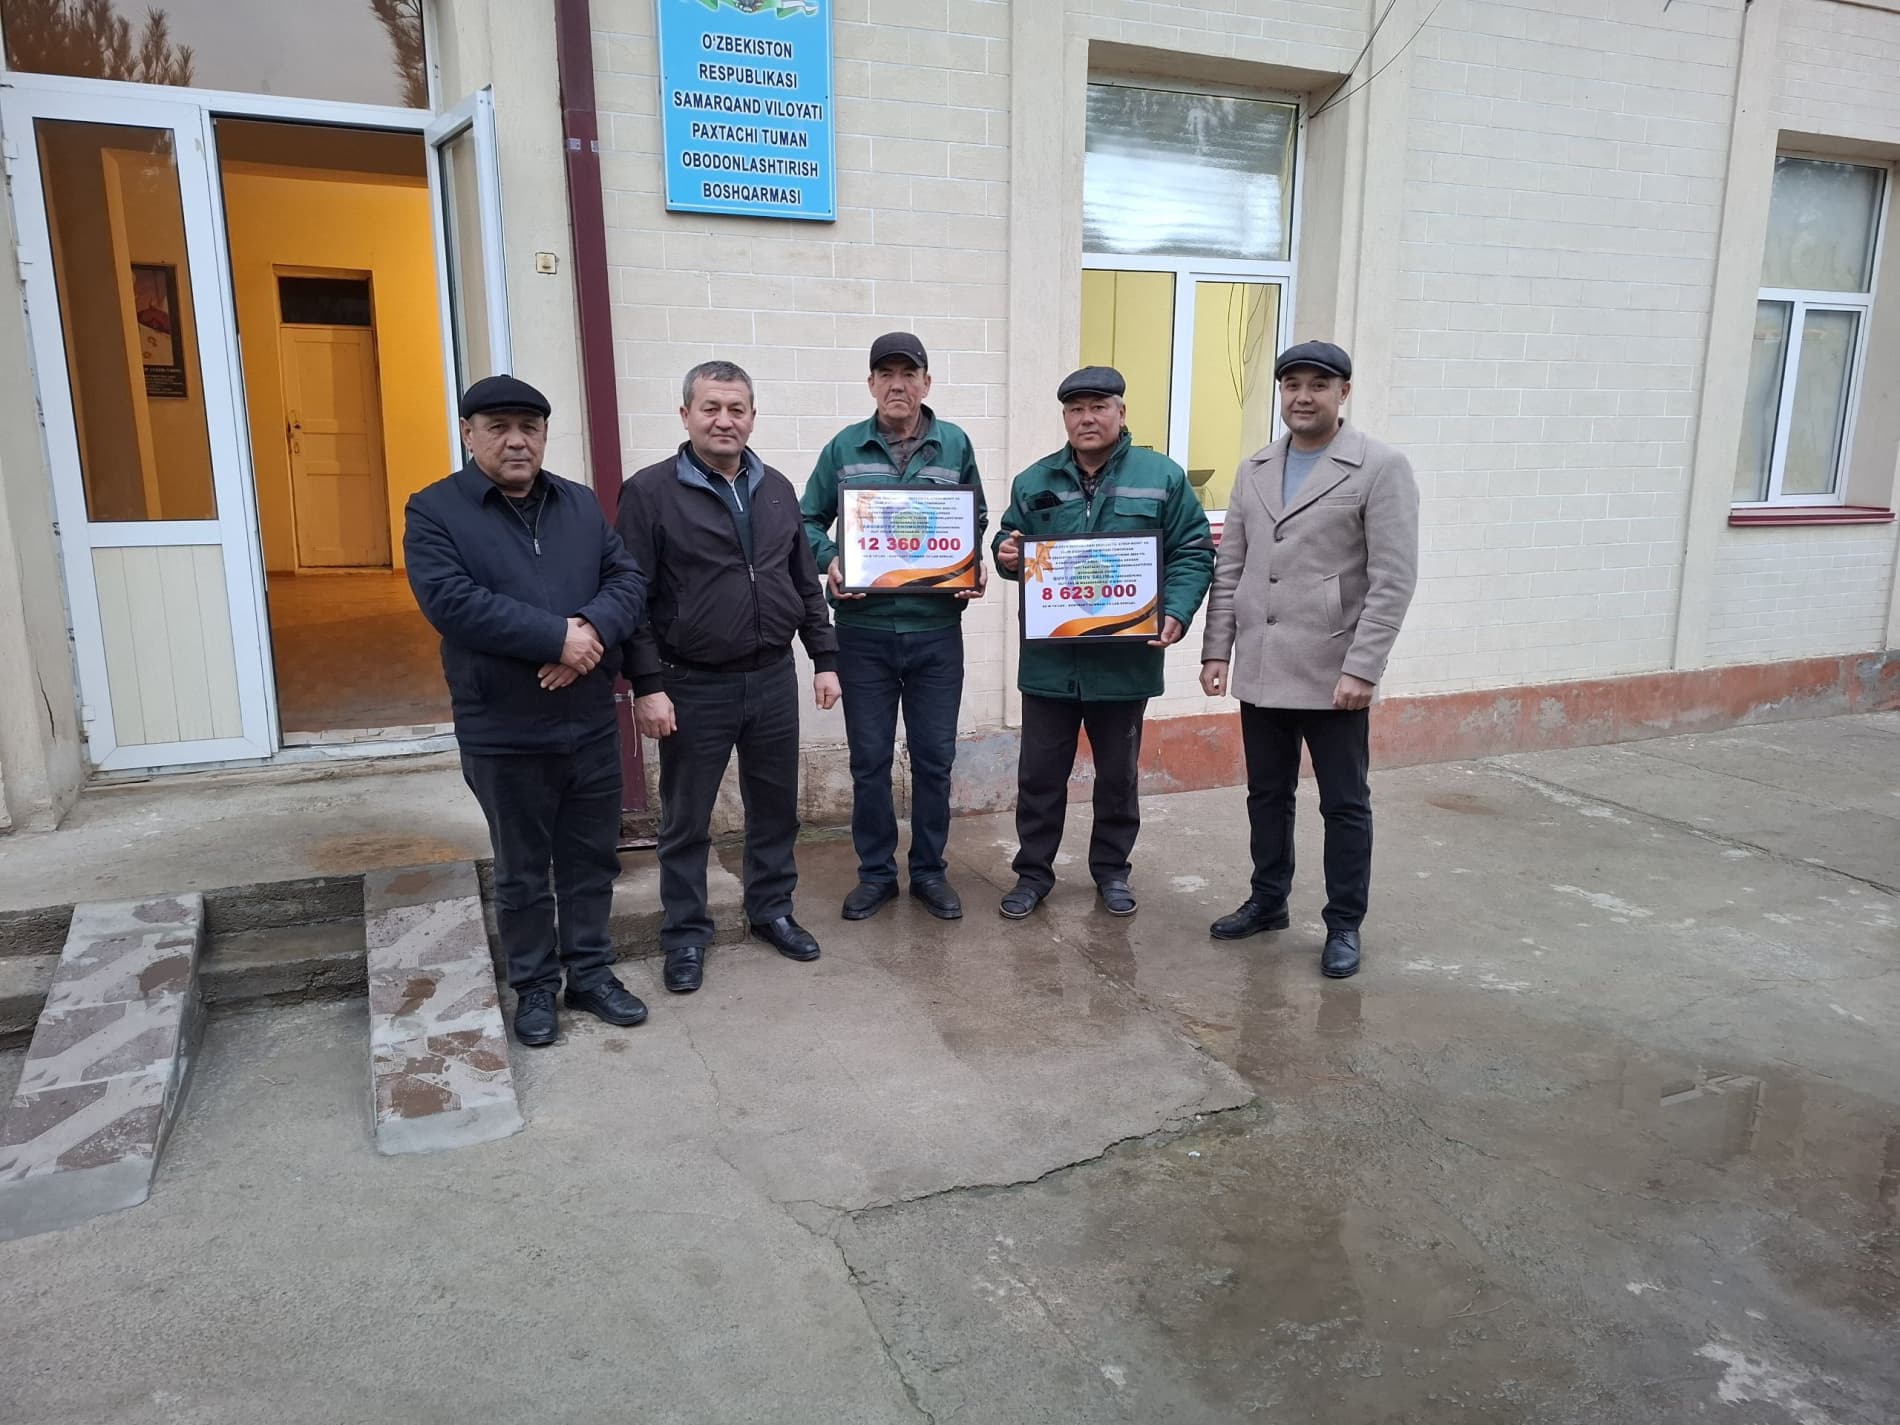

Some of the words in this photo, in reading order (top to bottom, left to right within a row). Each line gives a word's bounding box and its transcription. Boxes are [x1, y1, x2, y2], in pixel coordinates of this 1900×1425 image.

[699, 63, 797, 88] RESPUBLIKASI
[674, 91, 761, 115] SAMARQAND
[765, 100, 823, 120] VILOYATI
[692, 123, 758, 143] PAXTACHI
[762, 129, 807, 147] TUMAN
[682, 152, 818, 177] OBODONLASHTIRISH
[703, 183, 801, 204] BOSHQARMASI
[858, 537, 879, 550] 12
[887, 537, 920, 551] 360
[927, 538, 961, 551] 000
[1042, 587, 1053, 601] 8
[1060, 585, 1095, 600] 623
[1101, 583, 1137, 598] 000
